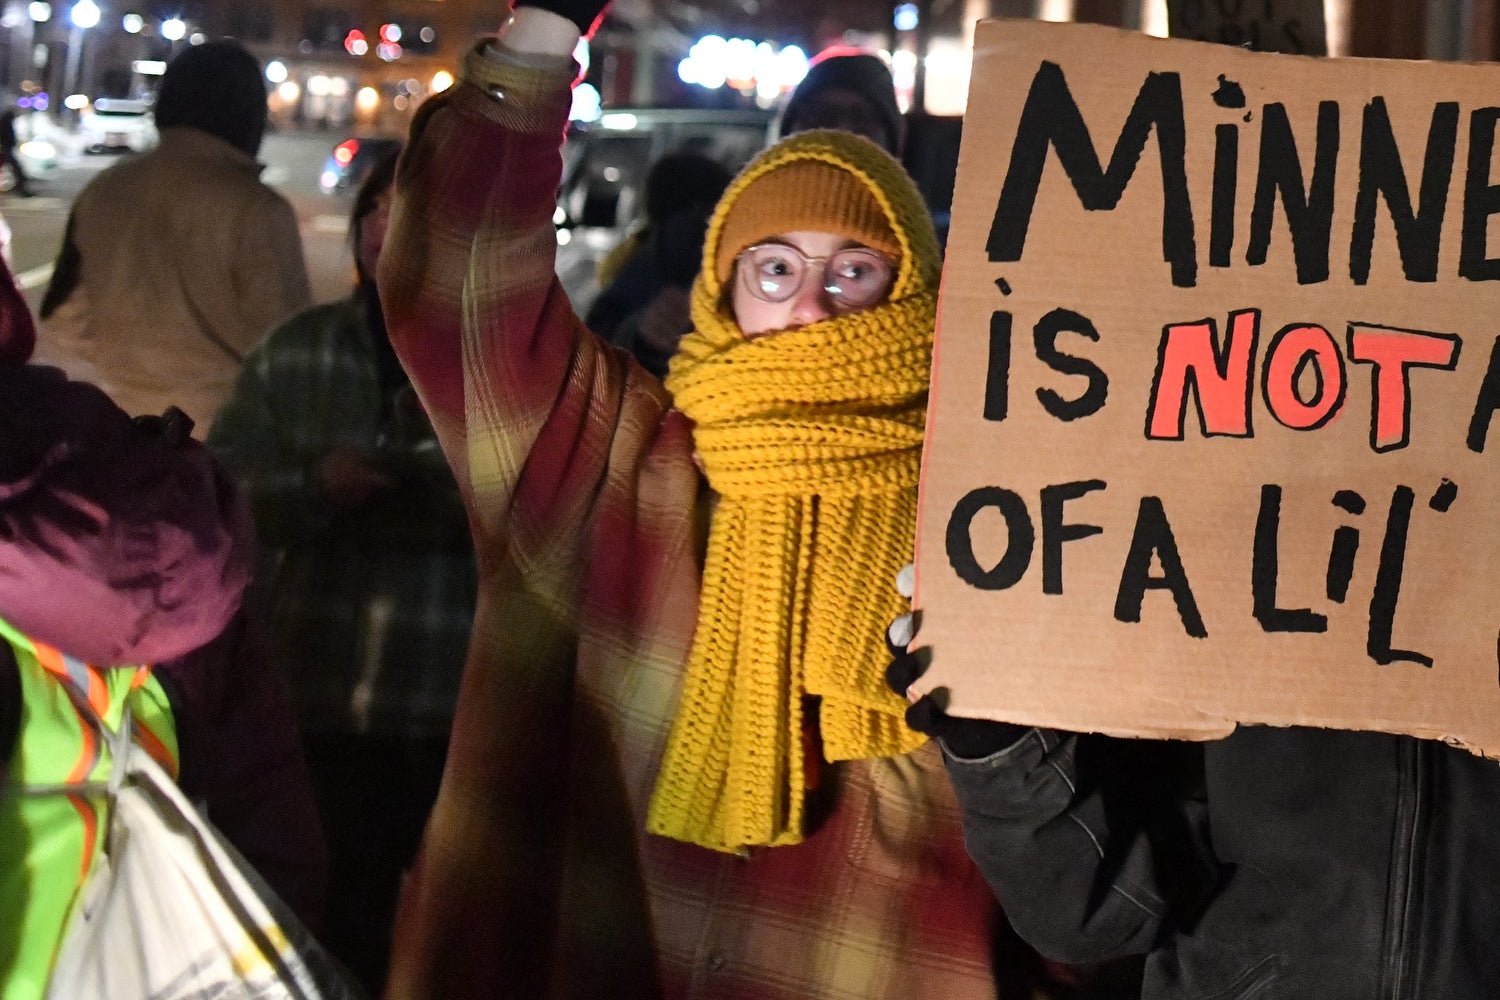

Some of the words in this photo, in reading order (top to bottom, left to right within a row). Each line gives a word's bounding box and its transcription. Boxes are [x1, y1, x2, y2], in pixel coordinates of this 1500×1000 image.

[1145, 308, 1462, 453] NOT
[945, 479, 1107, 596] OF
[1113, 496, 1208, 638] A
